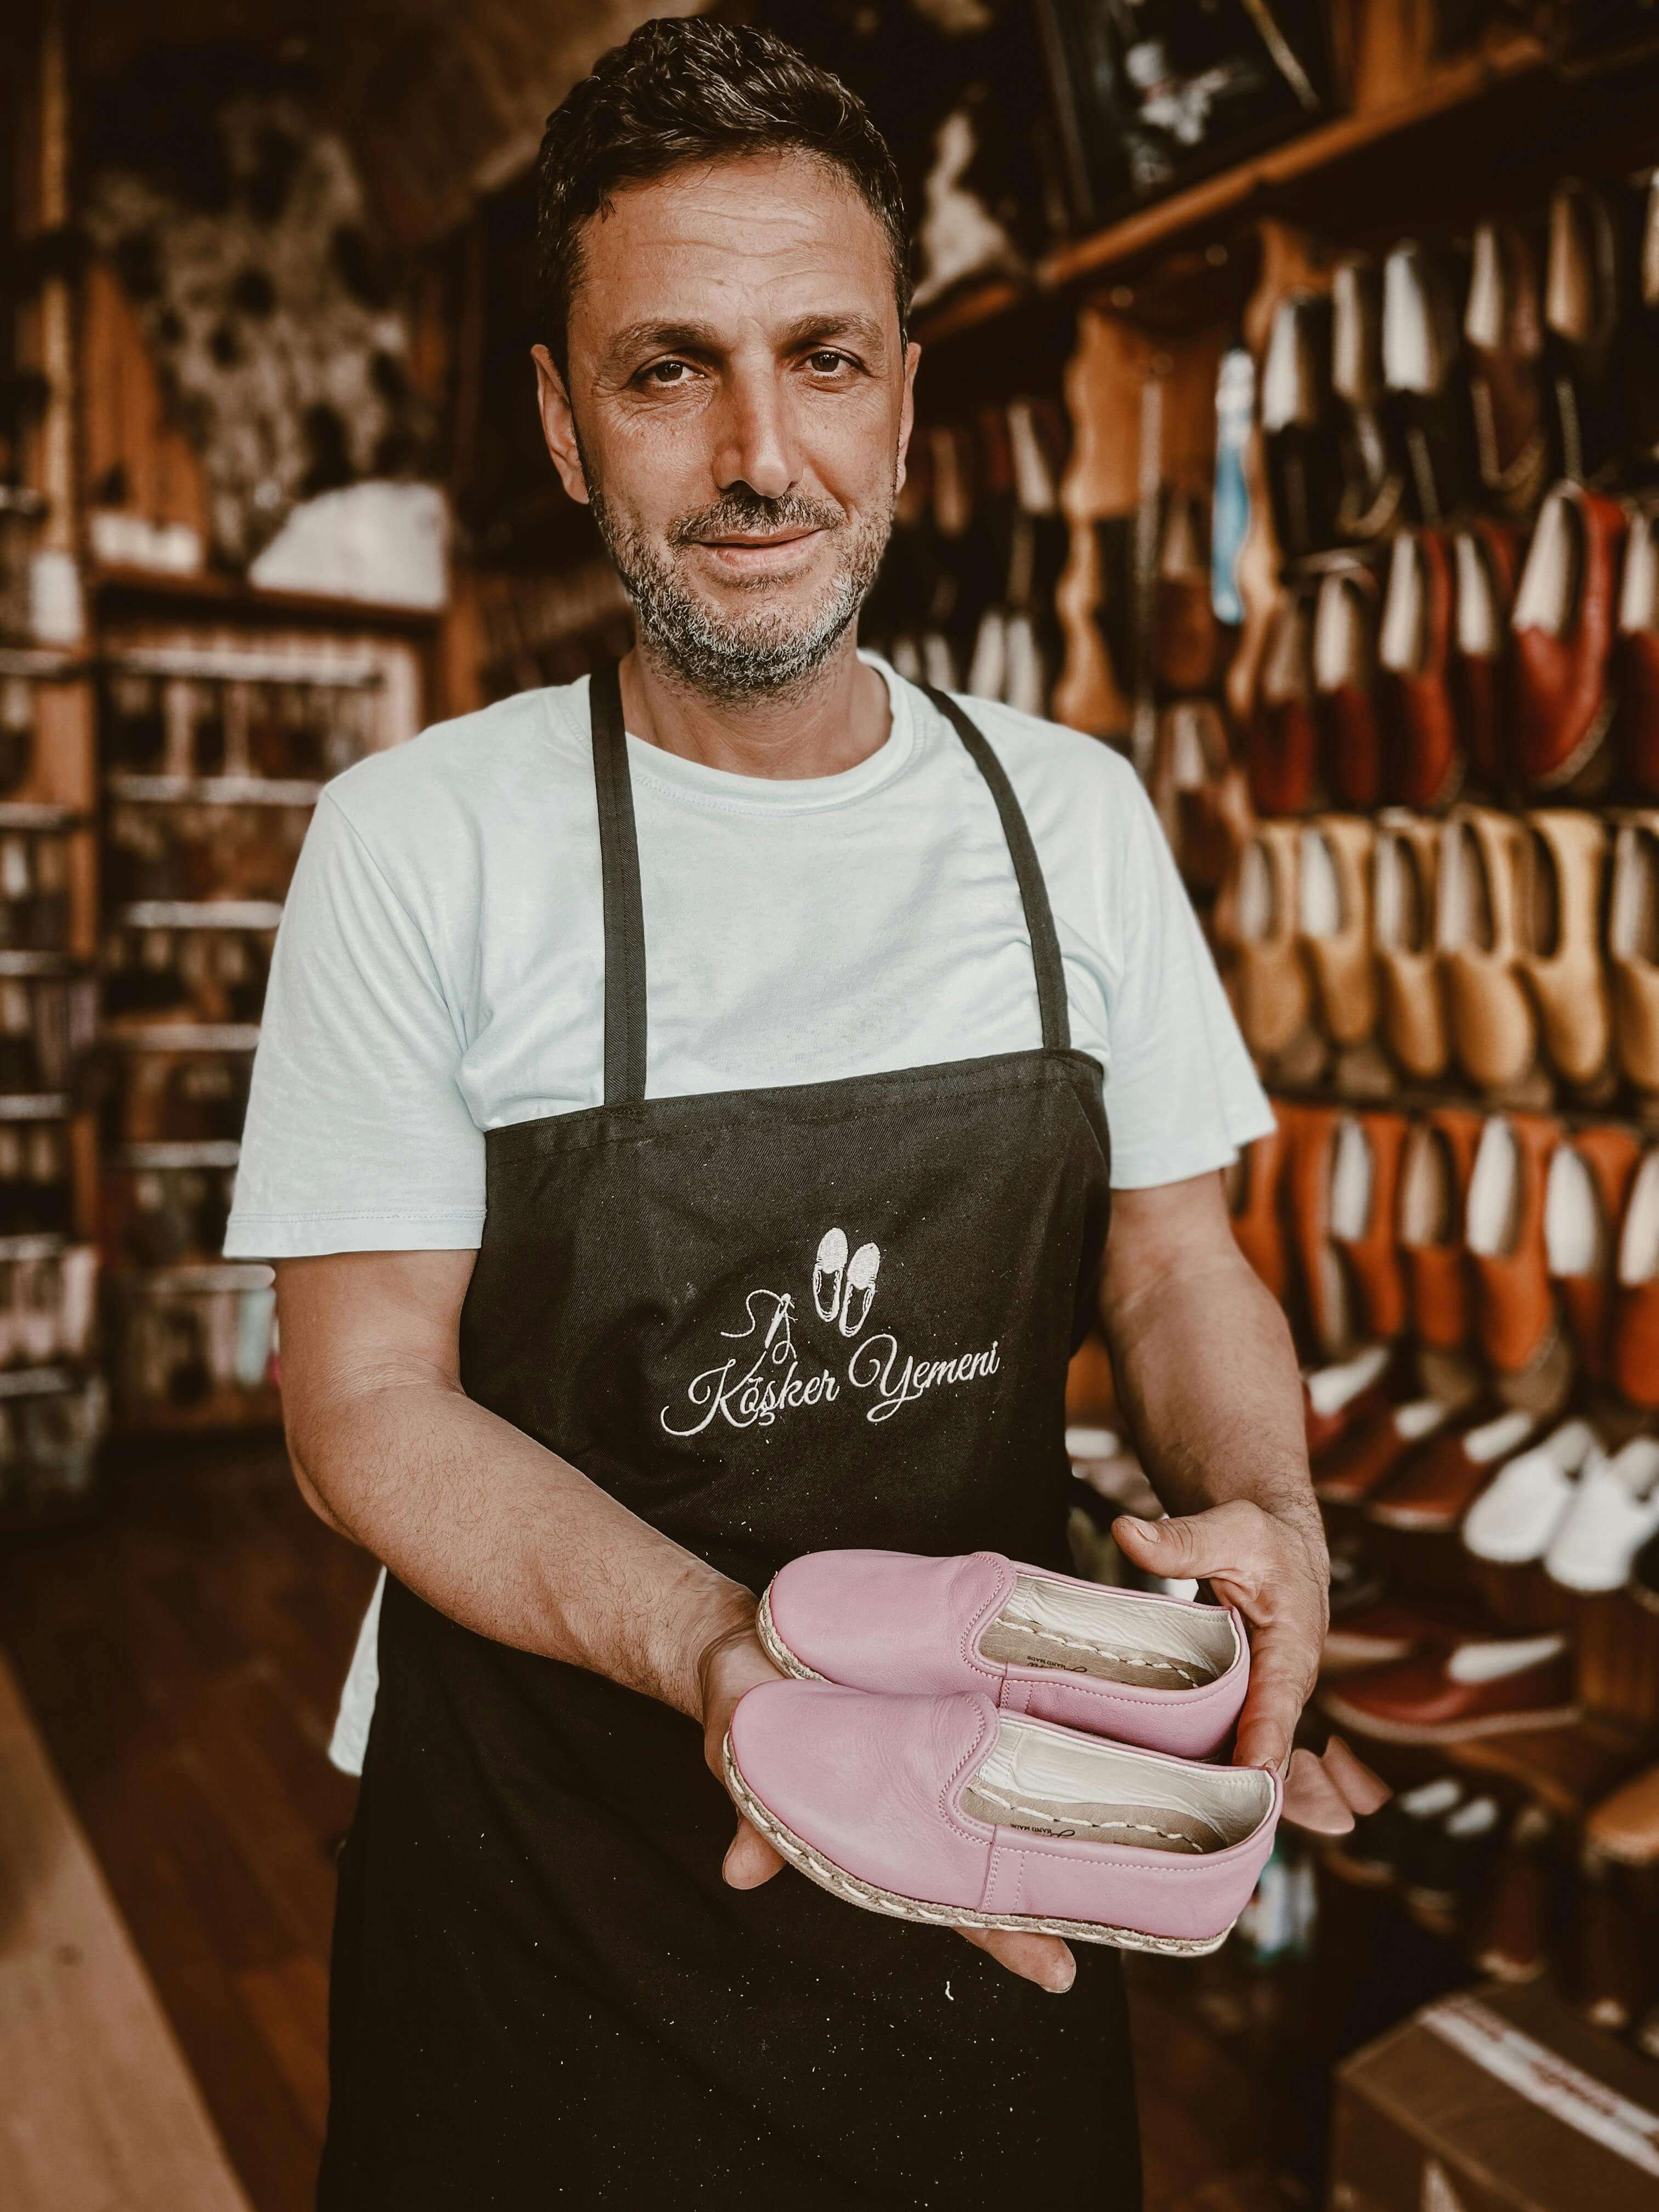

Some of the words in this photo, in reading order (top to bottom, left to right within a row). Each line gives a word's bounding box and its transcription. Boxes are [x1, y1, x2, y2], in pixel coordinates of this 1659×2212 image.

[848, 1334, 1000, 1423] Yemeni
[1027, 1655, 1046, 1664] MADE
[1047, 1660, 1066, 1669] HAND
